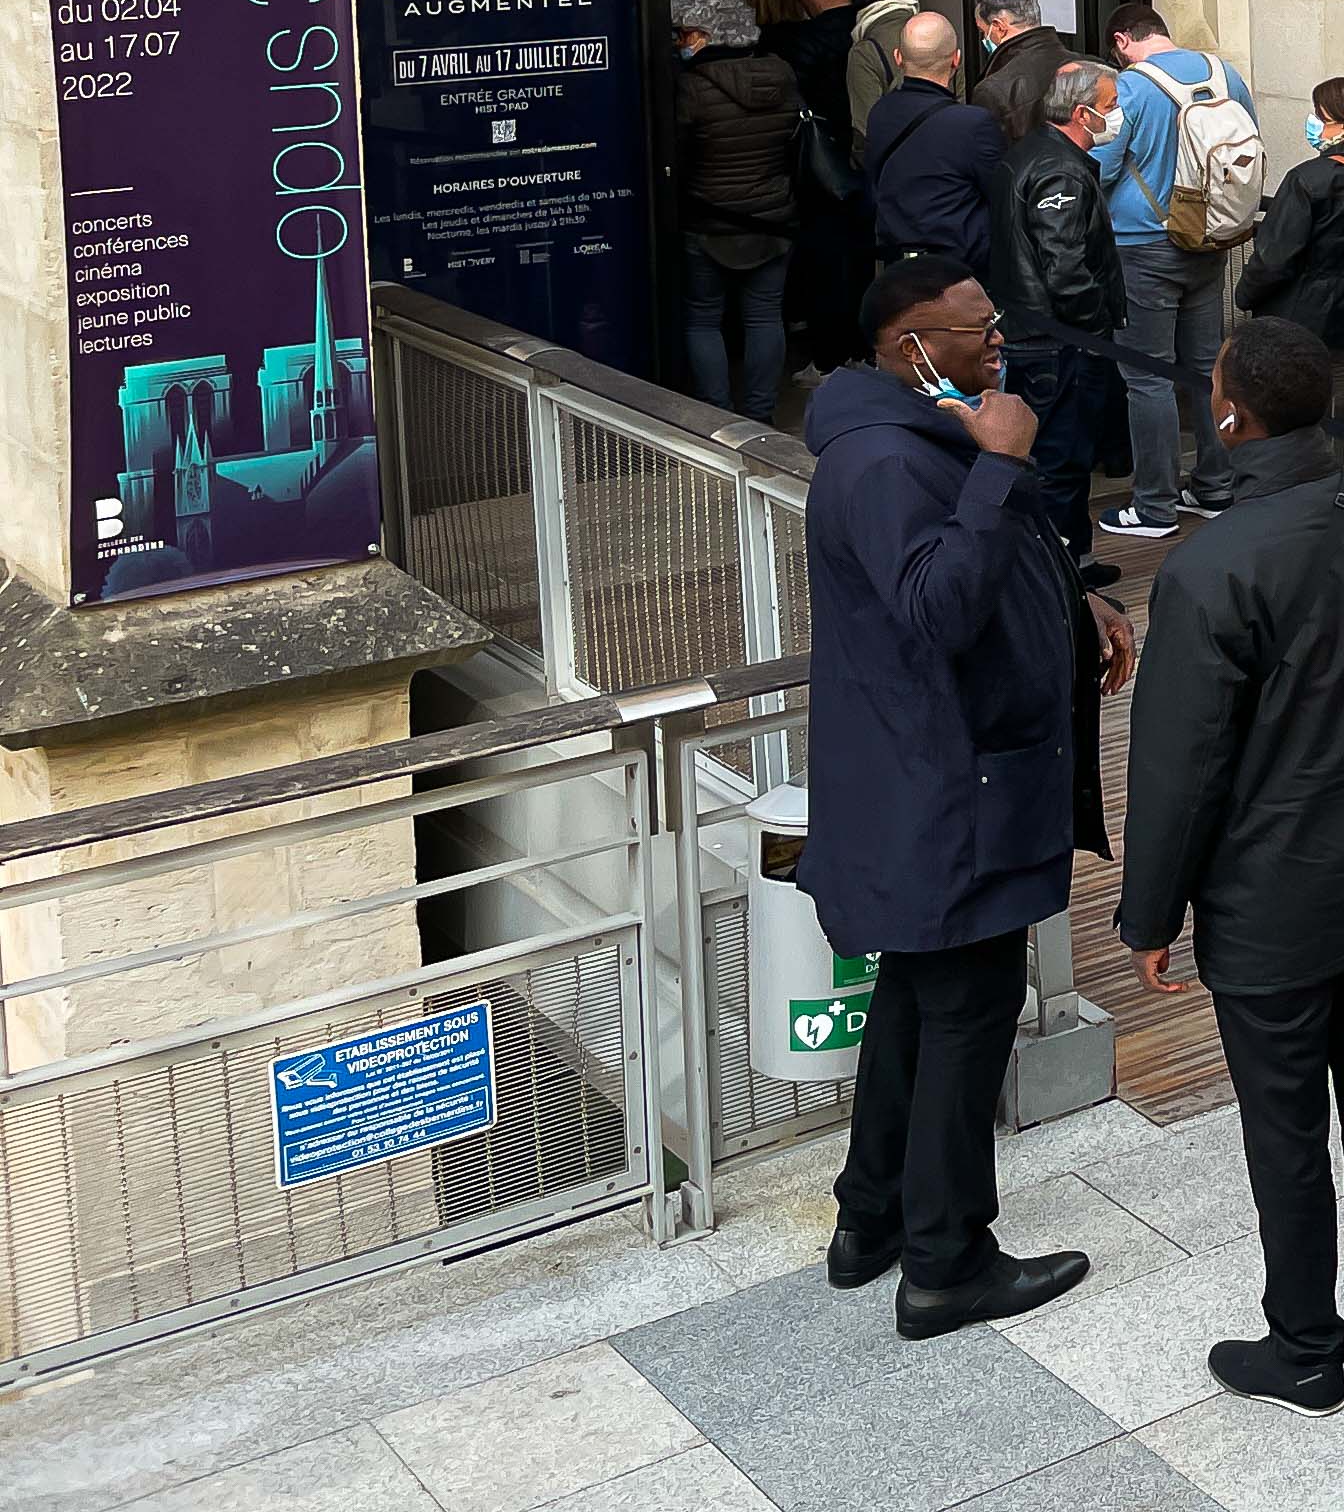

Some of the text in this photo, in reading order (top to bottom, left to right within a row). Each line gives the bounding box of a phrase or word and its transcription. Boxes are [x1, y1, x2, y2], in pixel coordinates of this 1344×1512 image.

[57, 0, 93, 24] du
[60, 31, 181, 63] au 17.07
[399, 43, 603, 79] DU 7 AVRIL AU 17 JUILLET 2022
[62, 71, 134, 101] 2022
[441, 85, 564, 105] ENTRÉE GRATUITE
[266, 24, 364, 259] opus
[433, 170, 582, 195] HORAIRES D'OUVERTURE
[72, 212, 153, 235] concerts
[73, 232, 189, 259] conférences
[74, 262, 143, 283] cinéma
[76, 281, 171, 308] exposition
[76, 302, 191, 335] jeune public
[79, 331, 153, 354] lectures
[336, 1024, 441, 1063] ETABLISSEMENT
[443, 1011, 479, 1030] SOUS
[347, 1029, 469, 1074] VIDEOPROTECTION
